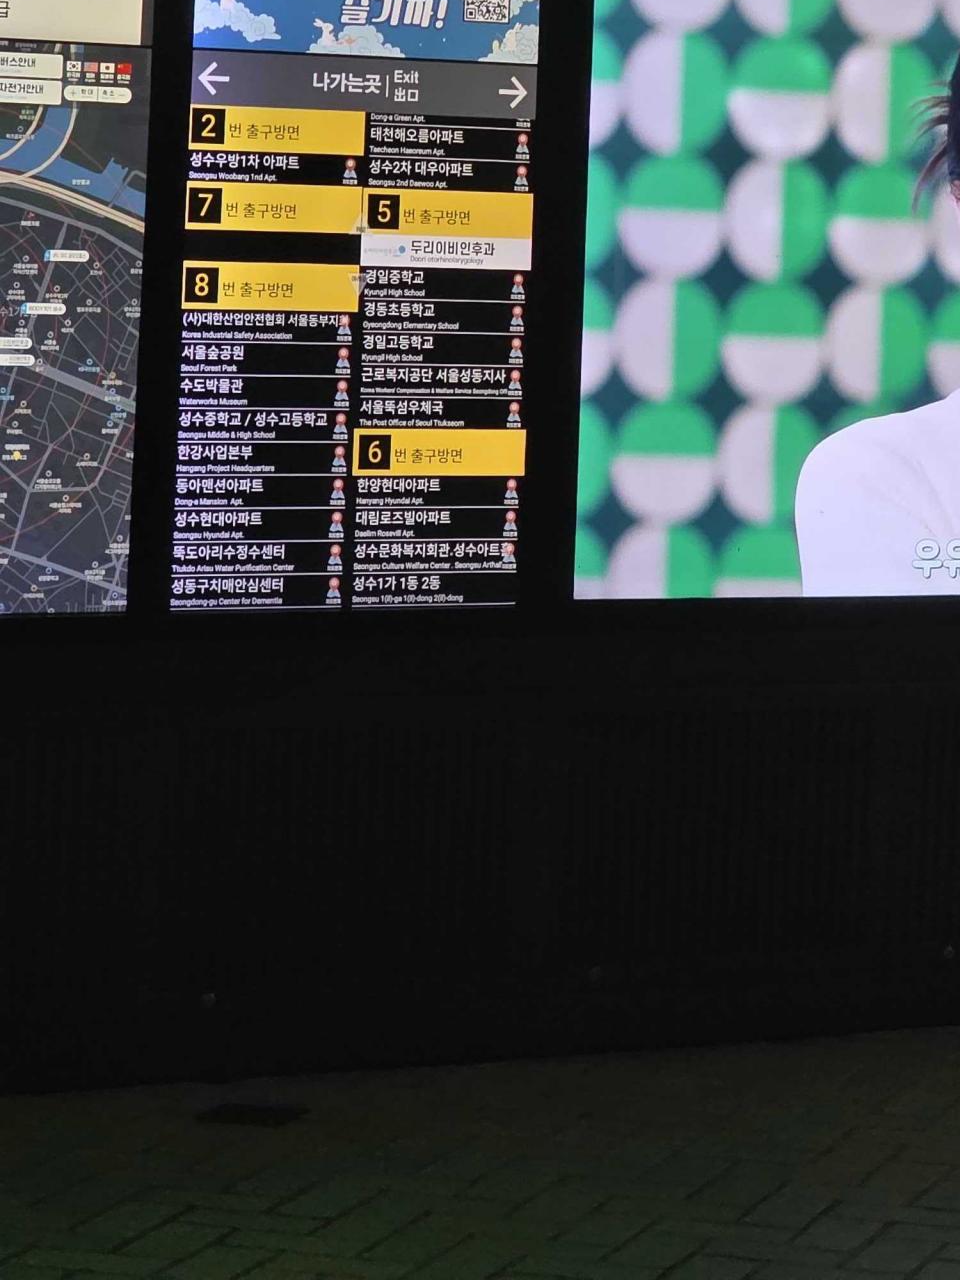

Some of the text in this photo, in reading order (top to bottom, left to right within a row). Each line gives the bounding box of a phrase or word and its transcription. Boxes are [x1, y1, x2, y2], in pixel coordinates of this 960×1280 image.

[313, 72, 382, 95] 나가는곳
[394, 70, 419, 85] Exit
[394, 88, 419, 103] 出口
[201, 114, 300, 141] 2 번 출구방면
[370, 127, 464, 144] 태천해오름아파트
[190, 152, 300, 170] 성수우방1차 아파트
[369, 160, 473, 177] 성수2차 대우아파트
[198, 193, 297, 220] 7 번 출구방면
[377, 200, 471, 226] 5 번 출구방면
[410, 240, 495, 257] 두리이비인후과
[194, 273, 294, 298] 8 번 출구방면
[365, 270, 424, 285] 경일중학교
[388, 289, 403, 297] High
[404, 289, 425, 297] School
[364, 302, 435, 317] 경동초등학교
[182, 312, 285, 327] (사)대한산업안전협회
[437, 322, 459, 330] School
[182, 331, 202, 339] Korea
[234, 332, 254, 340] Safety
[255, 332, 292, 340] Association
[363, 335, 434, 350] 경일고등학교
[182, 345, 244, 360] 서울숲공원
[385, 354, 400, 362] High
[401, 354, 423, 362] School
[181, 364, 199, 372] Seoul
[200, 364, 221, 372] Forest
[361, 368, 506, 383] 근로복지공단 서울성동지사
[180, 378, 243, 394] 수도박물관
[360, 400, 444, 415] 서울뚝섬우체국
[178, 411, 242, 427] 성수중학교
[254, 412, 328, 427] 성수고등학교
[253, 431, 276, 439] School
[177, 444, 253, 460] 한강사업본부
[368, 440, 463, 464] 6 번 출구방면
[176, 478, 264, 494] 동아맨션아파트
[357, 478, 440, 493] 한양현대아파트
[175, 511, 262, 527] 성수현대아파트
[355, 510, 451, 525] 대림로즈빌아파트
[173, 544, 286, 560] 뚝도아리수정수센터
[171, 578, 284, 594] 성동구치매안심센터
[353, 575, 441, 591] 성수1가 1동 2동
